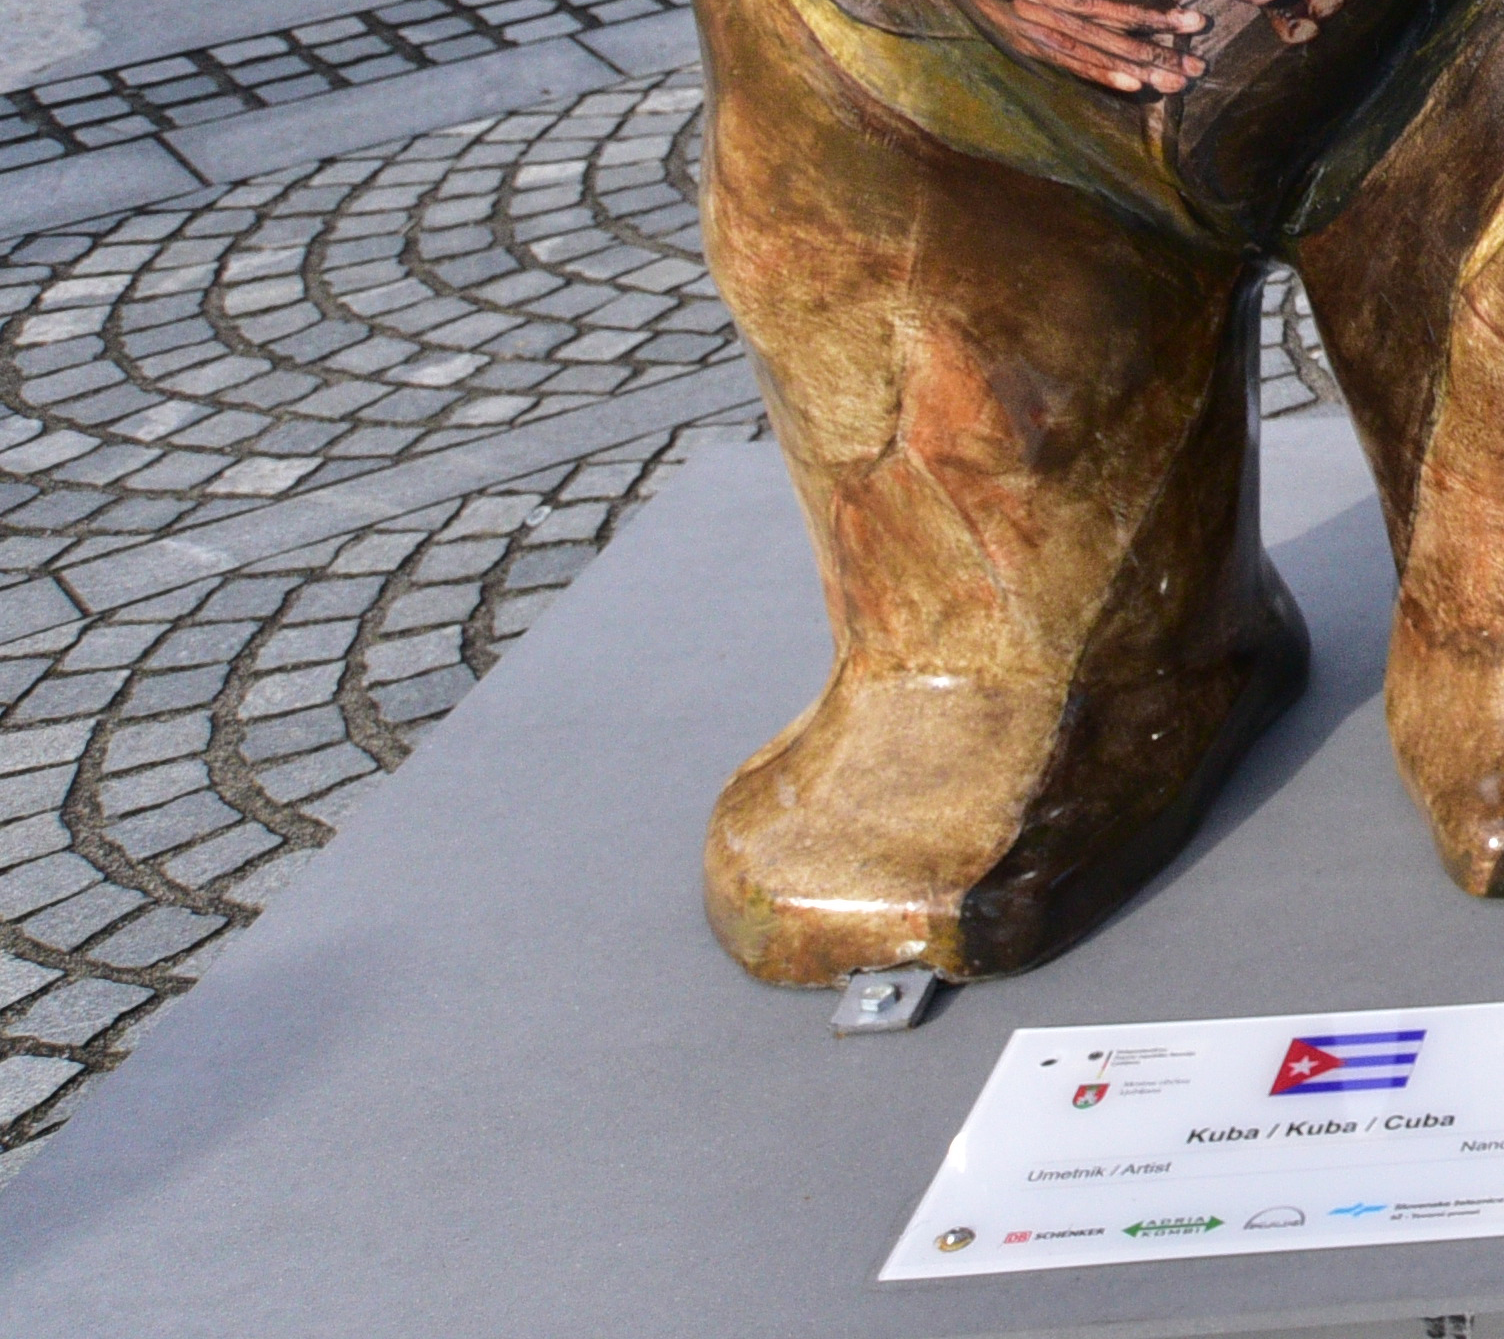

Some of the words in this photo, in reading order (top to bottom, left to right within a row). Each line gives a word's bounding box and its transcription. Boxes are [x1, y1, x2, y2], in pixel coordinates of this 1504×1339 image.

[1186, 1125, 1260, 1144] Kuba
[1285, 1119, 1358, 1137] Kuba
[1384, 1112, 1456, 1131] Cuba
[1027, 1166, 1105, 1182] Umetnik
[1120, 1161, 1173, 1176] Artist
[1146, 1217, 1206, 1227] ADRIA
[1034, 1227, 1106, 1241] SCHENKER
